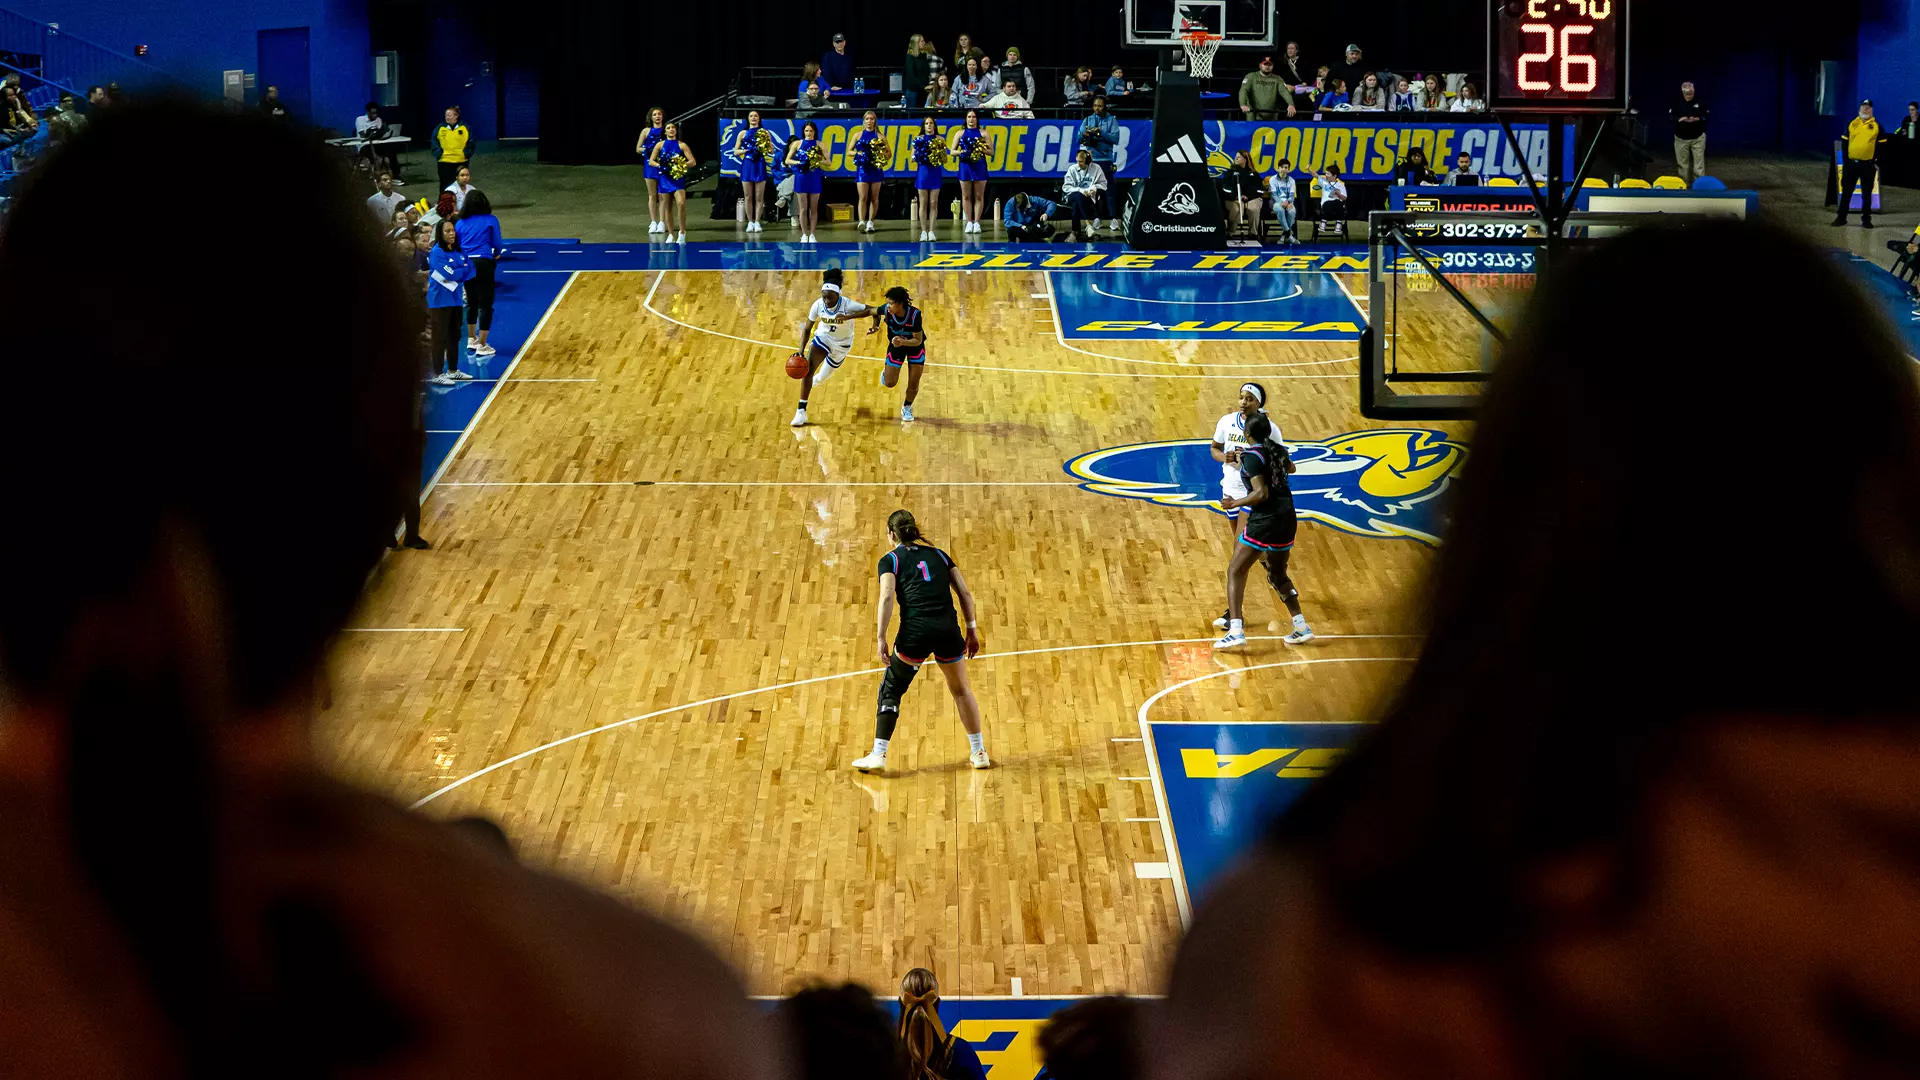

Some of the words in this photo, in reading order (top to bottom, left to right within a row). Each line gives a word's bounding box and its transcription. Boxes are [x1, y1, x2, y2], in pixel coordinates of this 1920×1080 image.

[1518, 24, 1596, 92] 26
[1033, 124, 1130, 172] CLB
[1250, 127, 1455, 174] COURTSIDE
[1461, 128, 1550, 175] CLUB
[913, 254, 1168, 269] BLUE
[917, 560, 931, 581] 1
